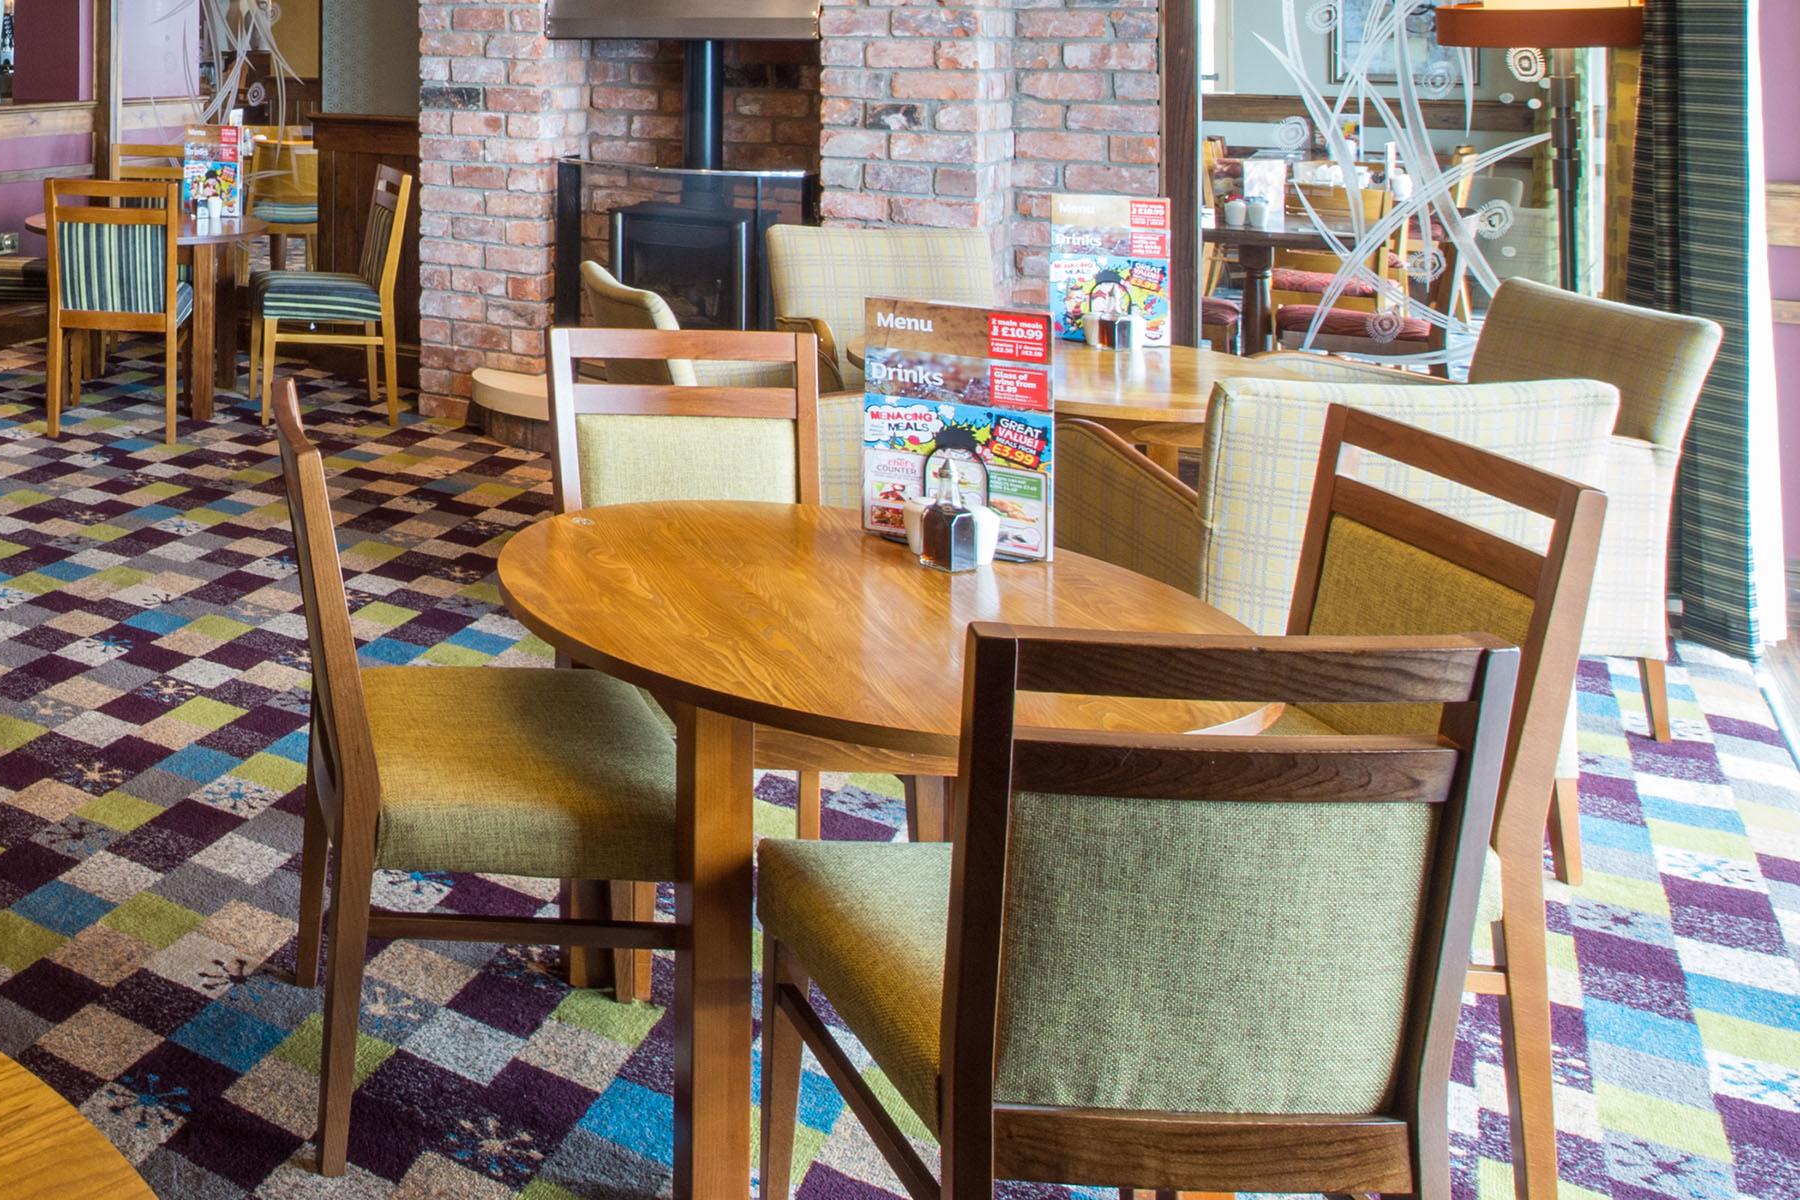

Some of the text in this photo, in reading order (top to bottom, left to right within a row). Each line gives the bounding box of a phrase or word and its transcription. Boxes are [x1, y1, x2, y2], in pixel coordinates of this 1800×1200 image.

[1059, 202, 1097, 214] Menu
[1055, 233, 1102, 247] Drinks
[876, 311, 934, 332] Menu
[1001, 326, 1043, 341] £10.99
[870, 361, 944, 386] Drinks
[994, 371, 1017, 380] Glass
[994, 378, 1037, 389] wine from
[870, 411, 933, 422] MENACING
[888, 422, 930, 432] MEALS
[1000, 418, 1042, 439] GREAT
[998, 426, 1040, 450] VALUE!
[992, 443, 1035, 466] £3.99
[876, 464, 917, 475] COUNTER
